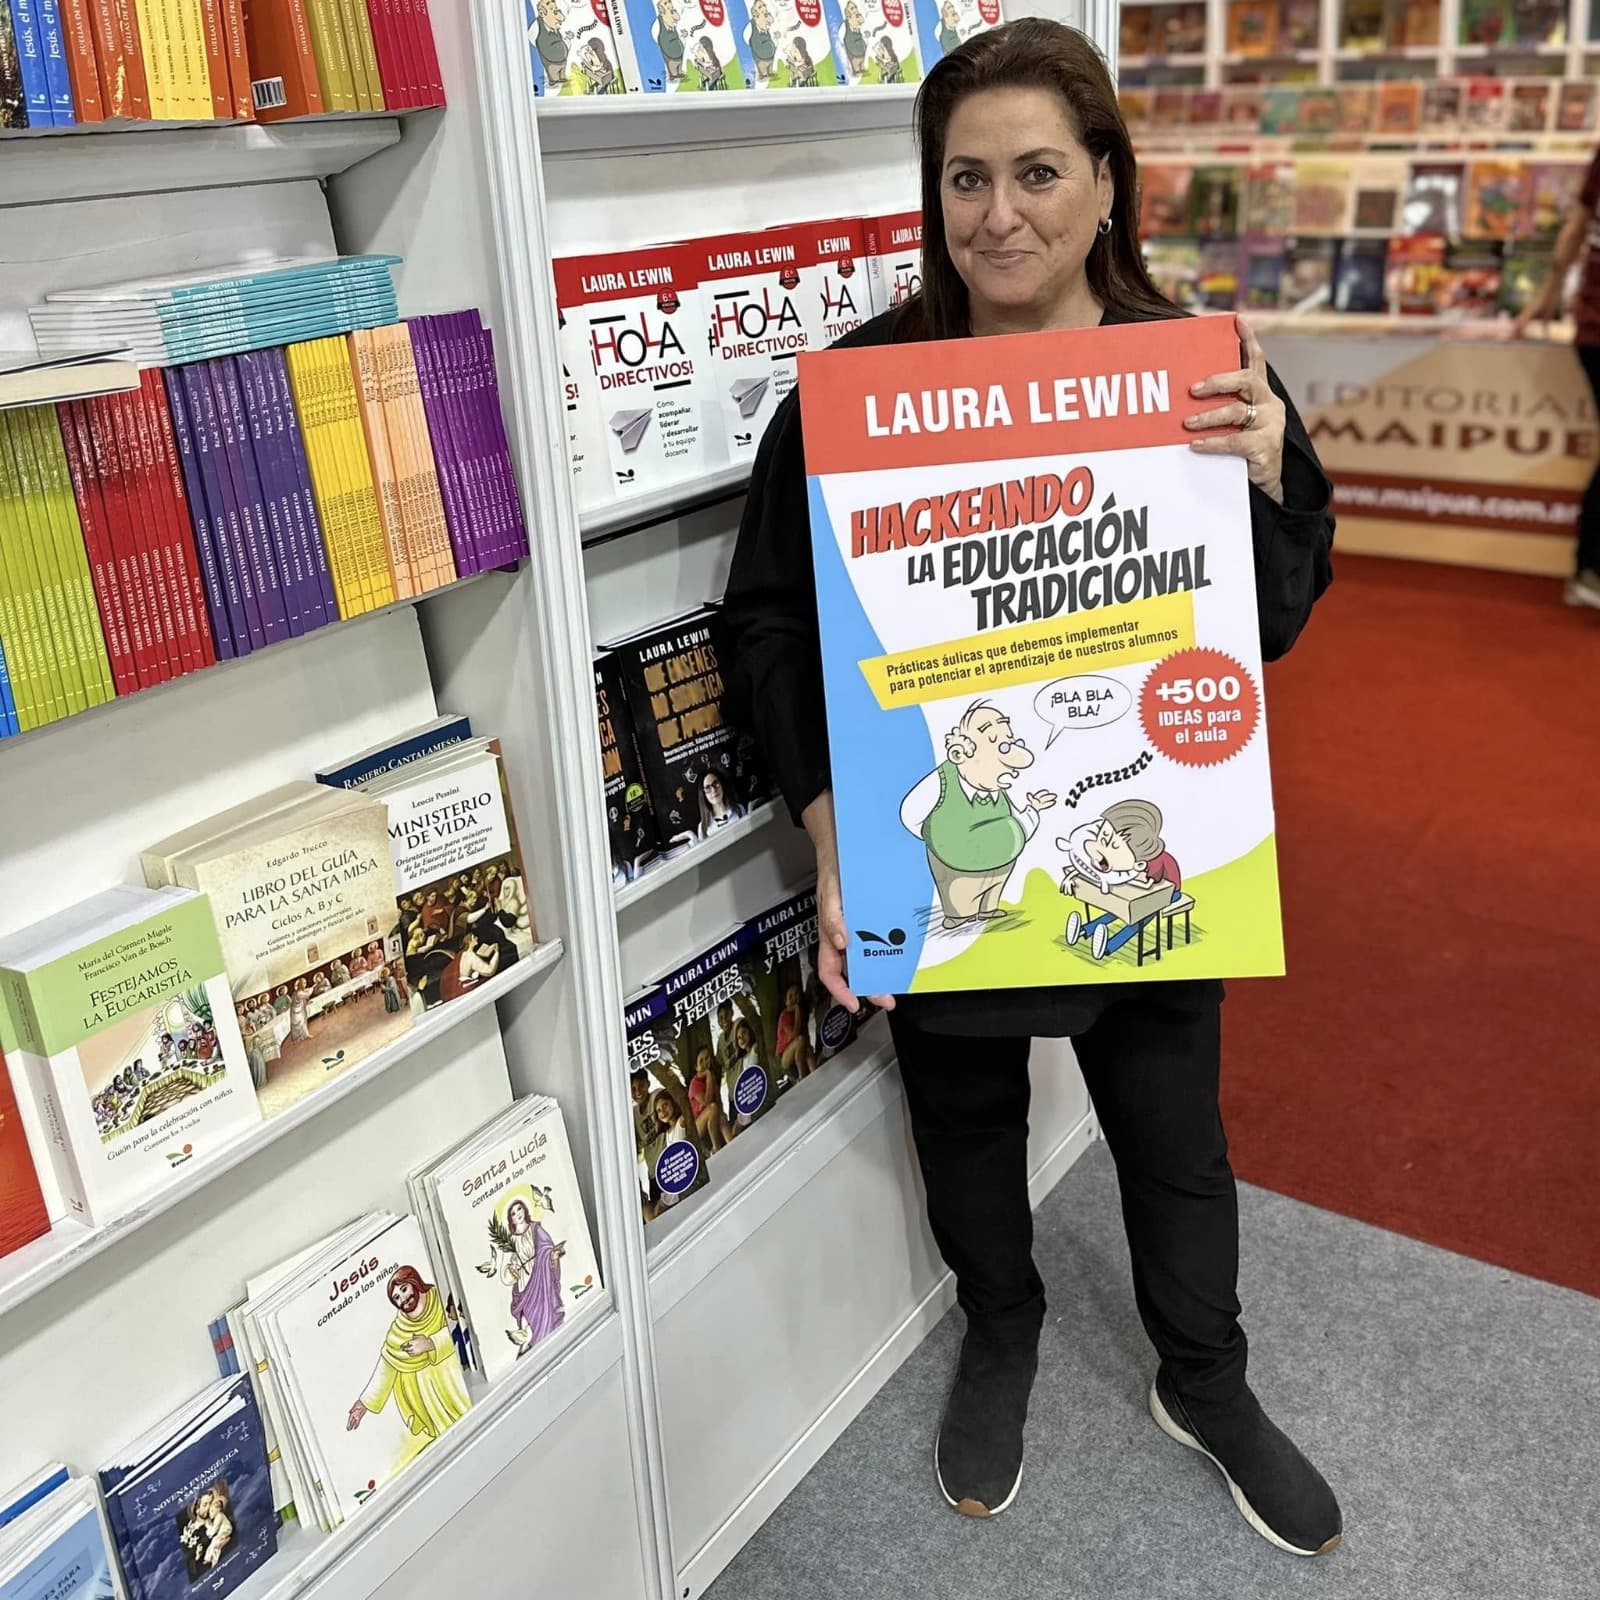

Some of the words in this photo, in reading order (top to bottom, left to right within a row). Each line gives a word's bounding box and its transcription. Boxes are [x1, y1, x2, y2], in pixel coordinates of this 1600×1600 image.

[18, 13, 30, 23] el
[42, 14, 55, 24] el
[208, 15, 215, 25] DE
[230, 16, 237, 26] DE
[76, 22, 87, 56] HUELLAS
[209, 27, 219, 56] HUELLAS
[231, 28, 241, 58] HUELLAS
[708, 251, 753, 272] LAURA
[755, 245, 796, 265] LEWIN
[818, 236, 851, 255] LEWIN
[581, 272, 627, 294] LAURA
[628, 266, 673, 288] LEWIN
[722, 332, 809, 360] DIRECTIVOS!
[600, 360, 695, 390] DIRECTIVOS!
[864, 384, 1013, 438] LAURA
[1028, 369, 1171, 424] LEWIN
[660, 419, 680, 429] liderar
[666, 426, 699, 438] desarrollar
[676, 437, 696, 447] equipo
[1308, 414, 1595, 460] MAIPUE
[850, 466, 1094, 559] HACKEANDO
[908, 554, 936, 586] LA
[942, 492, 1149, 589] EDUCACIÓN
[970, 545, 1212, 631] TRADICIONAL
[639, 641, 675, 663] LAURA
[676, 628, 711, 649] LEWIN
[886, 656, 940, 678] Prácticas
[942, 648, 983, 668] áulicas
[986, 645, 1008, 663] que
[1010, 633, 1063, 655] debemos
[1066, 620, 1140, 647] implementar
[890, 677, 916, 694] para
[918, 666, 972, 690] potenciar
[975, 662, 986, 677] el
[989, 651, 1056, 676] aprendizaje
[1058, 647, 1073, 662] de
[1076, 638, 1126, 659] nuestros
[1128, 628, 1179, 649] alumnos
[666, 644, 718, 684] ENSEÑES
[1050, 690, 1082, 708] ¡BLA
[1086, 688, 1114, 703] BLA
[1156, 676, 1241, 705] +500
[1068, 704, 1101, 719] BLA!
[1158, 710, 1203, 728] IDEAS
[1207, 708, 1242, 728] para
[1174, 729, 1191, 745] el
[1194, 726, 1228, 743] aula
[343, 765, 387, 790] RANIERO
[388, 735, 462, 770] CANTALAMESSA
[388, 792, 492, 839] MINISTERIO
[407, 830, 431, 849] DE
[434, 814, 478, 837] VIDA
[266, 850, 300, 869] Edgardo
[302, 840, 328, 855] Trucco
[396, 845, 443, 868] Orientaciones
[444, 838, 460, 852] para
[462, 826, 493, 842] ministros
[404, 864, 412, 873] de
[422, 848, 457, 866] Eucaristía
[464, 837, 488, 851] agentes
[409, 870, 417, 880] de
[419, 860, 447, 877] Pastoral
[448, 856, 456, 864] de
[466, 844, 486, 857] Salud
[225, 904, 266, 929] PARA
[270, 896, 289, 912] LA
[292, 874, 341, 903] SANTA
[344, 858, 378, 882] MISA
[242, 878, 286, 905] LIBRO
[290, 866, 318, 887] DEL
[322, 849, 359, 873] GUÍA
[272, 912, 302, 930] Ciclos
[318, 900, 326, 911] B
[327, 899, 333, 912] y
[335, 892, 344, 903] C
[758, 906, 795, 934] LAURA
[764, 914, 819, 956] FUERTE
[764, 956, 774, 975] y
[776, 930, 818, 964] FELIC
[864, 946, 904, 958] Bonum
[78, 956, 101, 973] María
[102, 948, 115, 961] del
[116, 937, 147, 955] Carmen
[84, 960, 121, 981] Francisco
[121, 952, 138, 963] Van
[138, 946, 148, 955] de
[149, 936, 172, 951] Bosch
[665, 964, 704, 995] LAURA
[705, 940, 739, 971] LEWIN
[84, 1012, 103, 1029] LA
[105, 969, 192, 1018] EUCARISTÍA
[90, 958, 178, 1008] FESTEJAMOS
[673, 962, 740, 1019] FUERTES
[625, 1004, 652, 1028] WIN
[672, 1019, 683, 1039] y
[686, 976, 744, 1027] FELICES
[107, 1144, 132, 1161] Guión
[132, 1134, 150, 1149] para
[150, 1128, 159, 1137] la
[160, 1106, 198, 1133] celebración
[200, 1099, 213, 1110] con
[214, 1088, 233, 1102] niños
[462, 1160, 507, 1197] Santa
[510, 1132, 548, 1165] Lucía
[472, 1181, 504, 1209] contada
[505, 1176, 512, 1185] a
[512, 1167, 525, 1180] los
[526, 1154, 547, 1171] niños
[317, 1295, 354, 1327] contado
[354, 1290, 361, 1300] a
[361, 1280, 375, 1294] los
[376, 1262, 400, 1283] niños
[329, 1256, 380, 1302] Jesús
[154, 1485, 189, 1514] NOVENA
[189, 1447, 240, 1488] EVANGÉLICA
[57, 1564, 81, 1589] PARA
